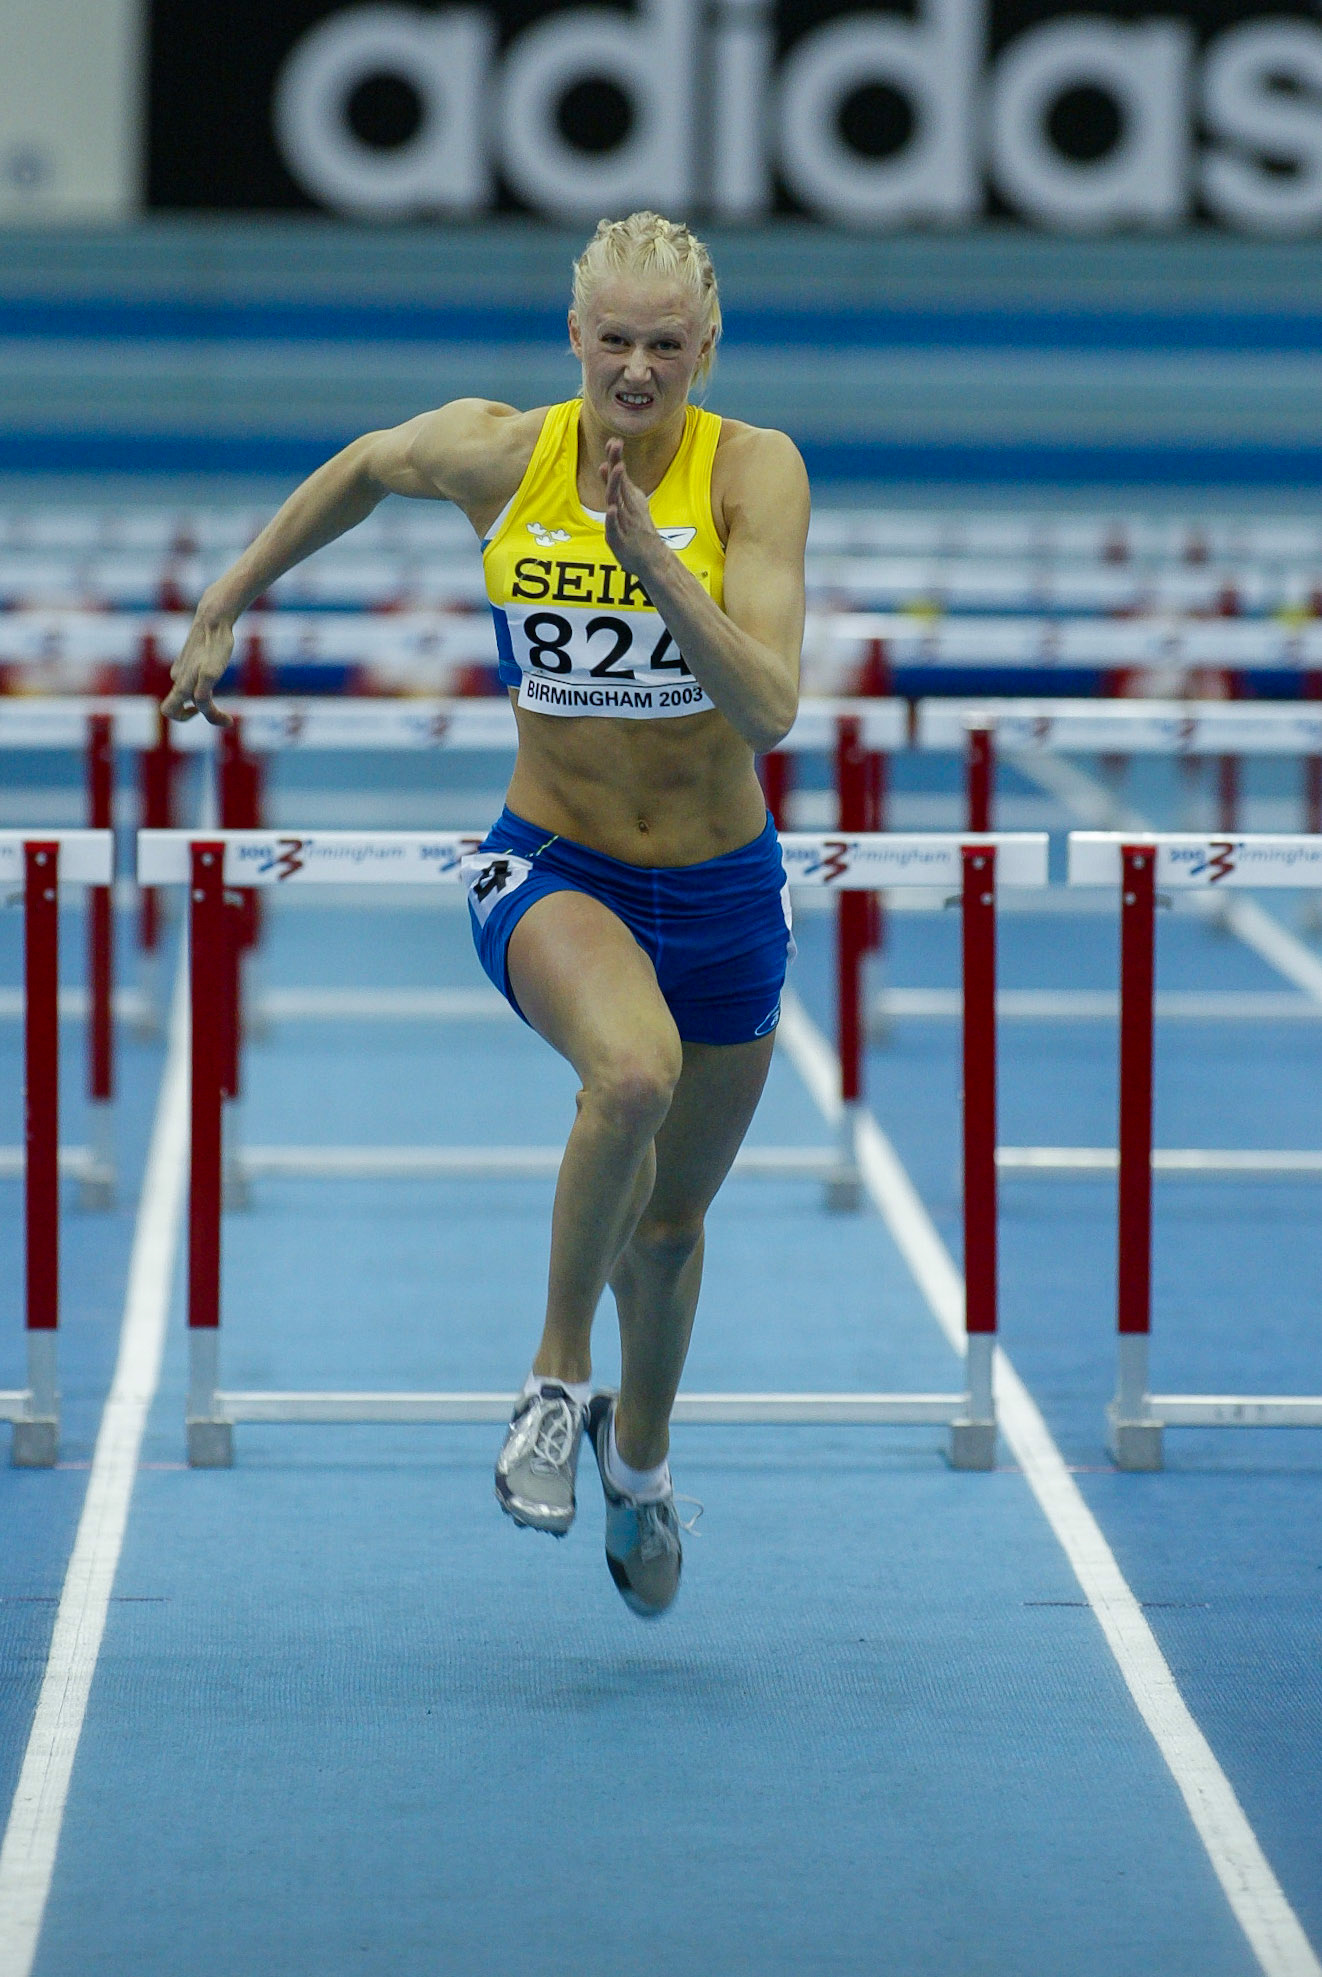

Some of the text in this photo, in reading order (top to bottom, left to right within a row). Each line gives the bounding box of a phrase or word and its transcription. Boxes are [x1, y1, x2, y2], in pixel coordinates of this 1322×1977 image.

[274, 0, 1322, 229] adidas
[512, 557, 657, 606] SEIK
[523, 612, 693, 680] 824
[527, 680, 703, 709] BIRMINGHAM 2003
[473, 860, 512, 902] 4
